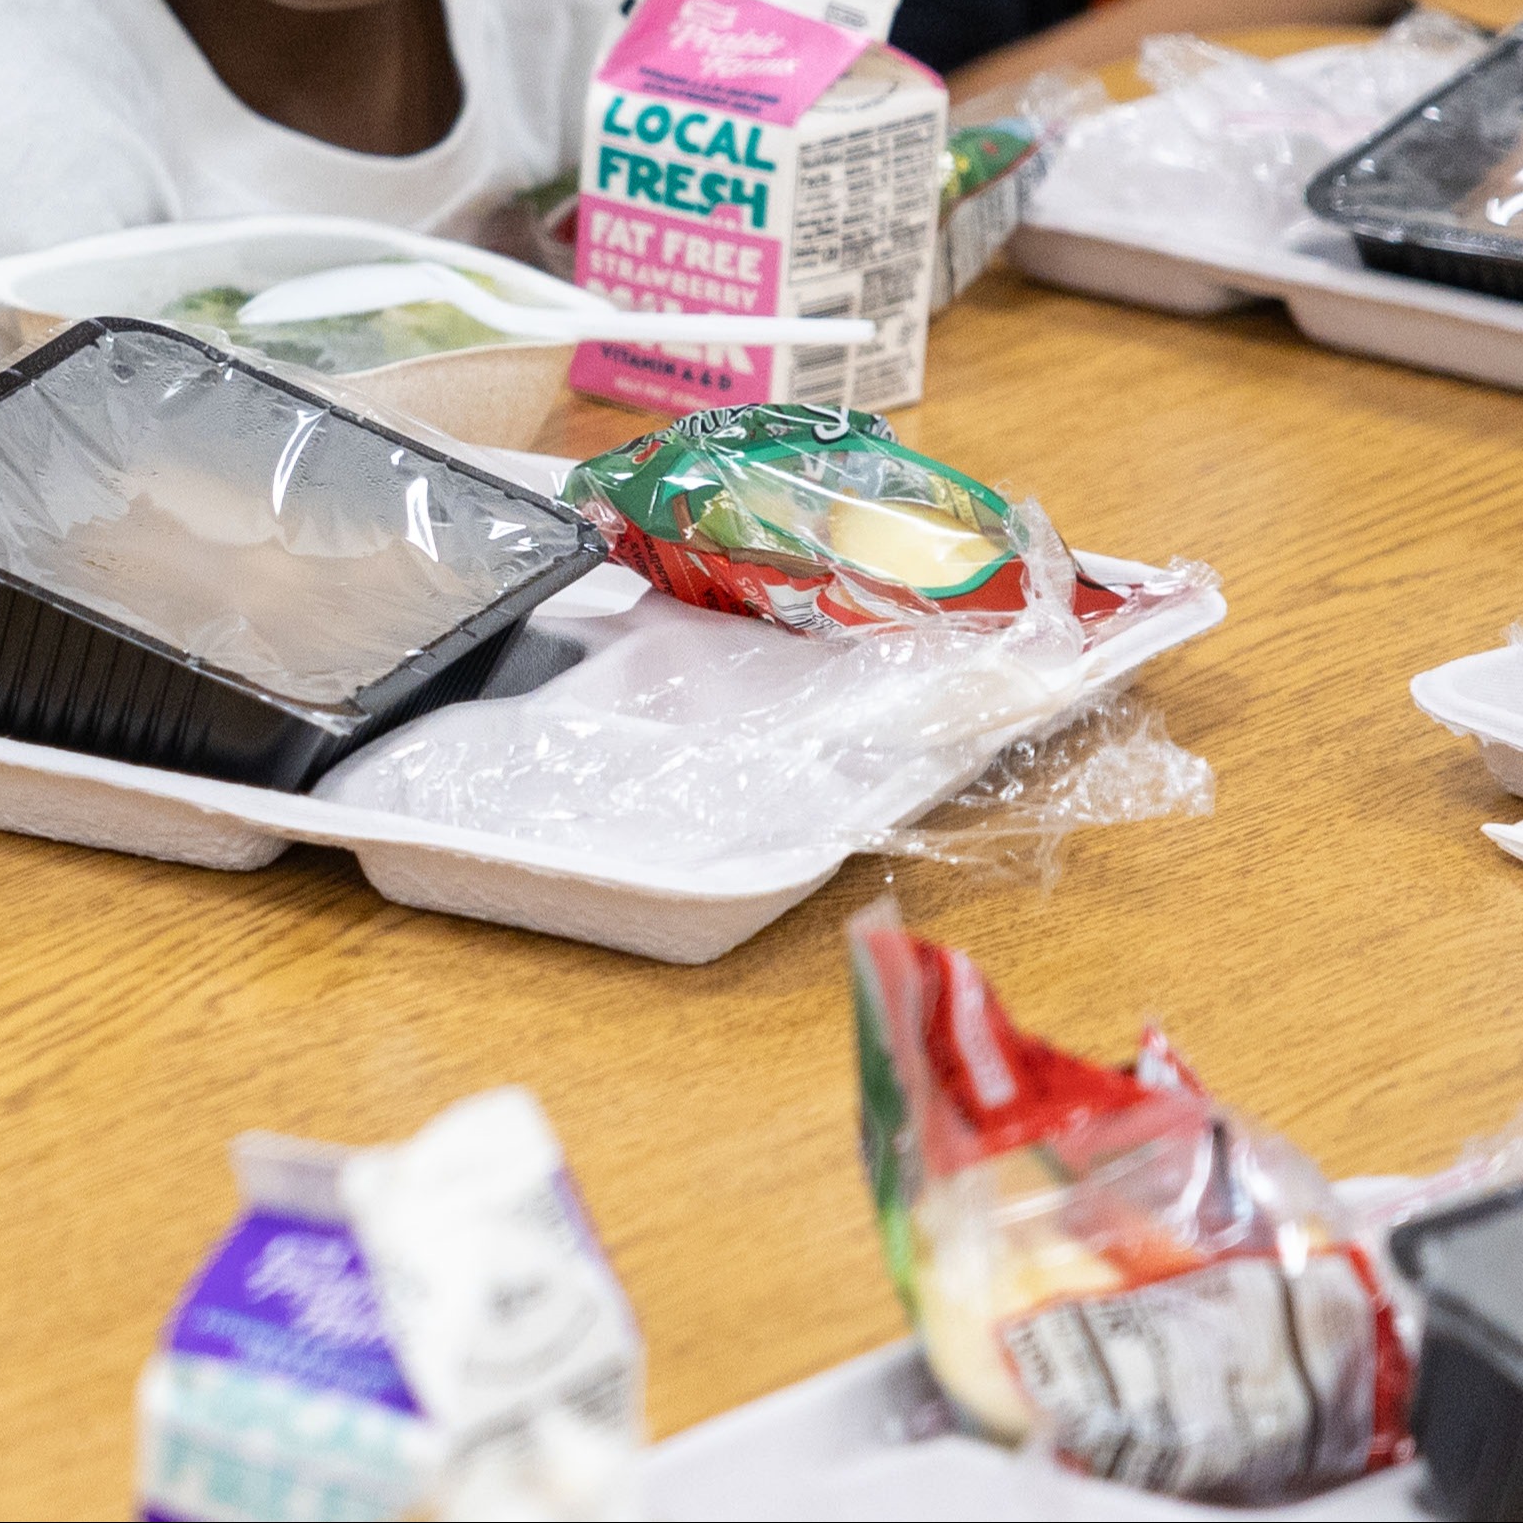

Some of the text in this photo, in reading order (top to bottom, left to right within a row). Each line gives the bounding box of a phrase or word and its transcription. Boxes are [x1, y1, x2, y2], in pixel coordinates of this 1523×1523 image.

[602, 96, 776, 172] LOCAL
[597, 144, 769, 228] FRESH
[588, 247, 757, 310] STRAWBERRY
[589, 209, 764, 285] FAT FREE
